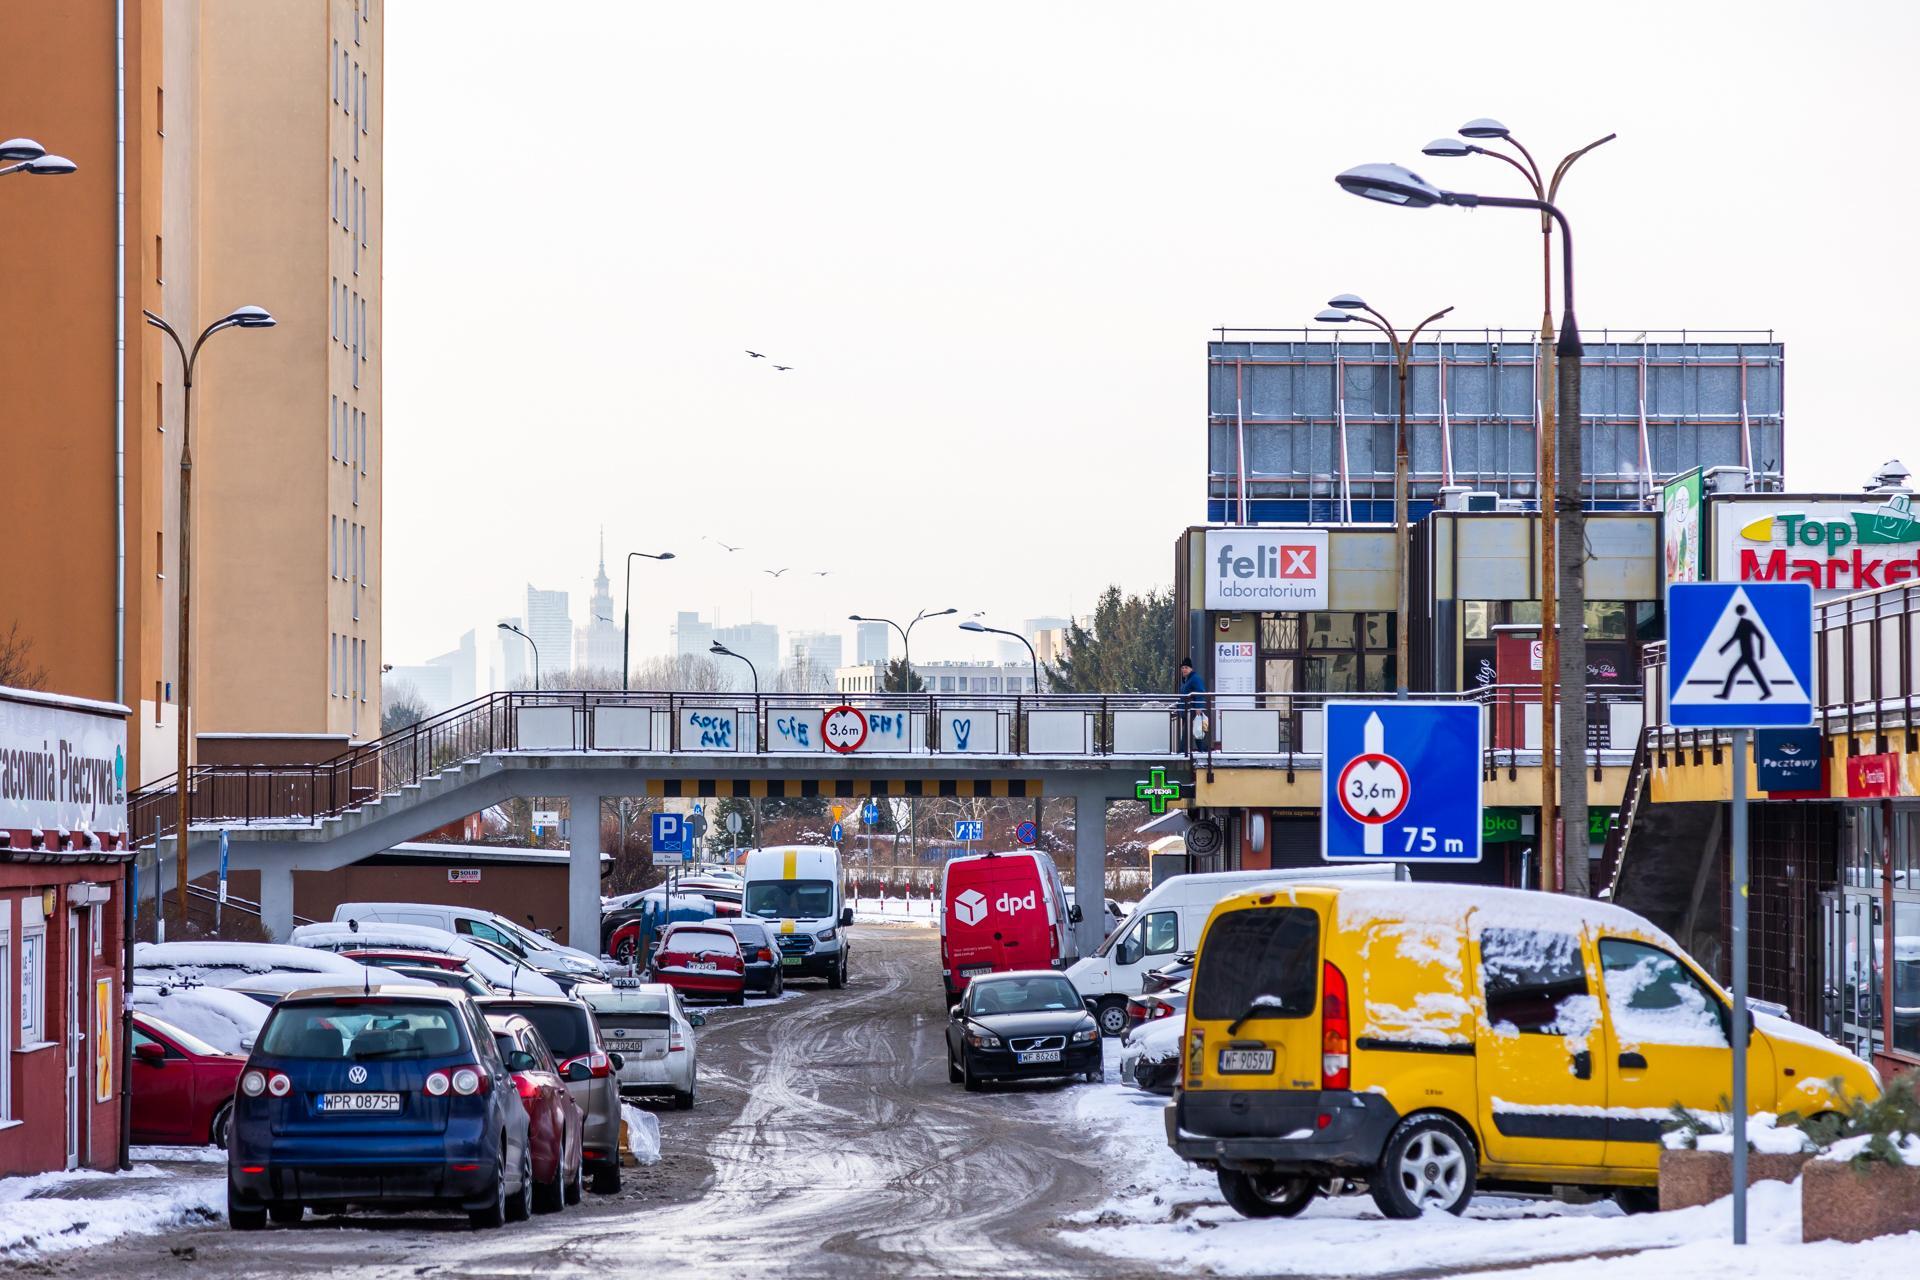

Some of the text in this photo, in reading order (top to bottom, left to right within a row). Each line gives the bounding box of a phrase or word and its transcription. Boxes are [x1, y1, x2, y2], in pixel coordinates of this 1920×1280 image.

[1777, 513, 1851, 556] Top
[1219, 581, 1316, 598] laboratorium
[1763, 758, 1818, 769] Pocztowy
[0, 739, 113, 822] acownia Pieczywa
[1403, 827, 1463, 852] 75 m
[995, 890, 1036, 916] dpd
[1022, 1053, 1034, 1061] WF
[1225, 1053, 1272, 1069] WF 9059V
[325, 1095, 398, 1109] WPR 0875P
